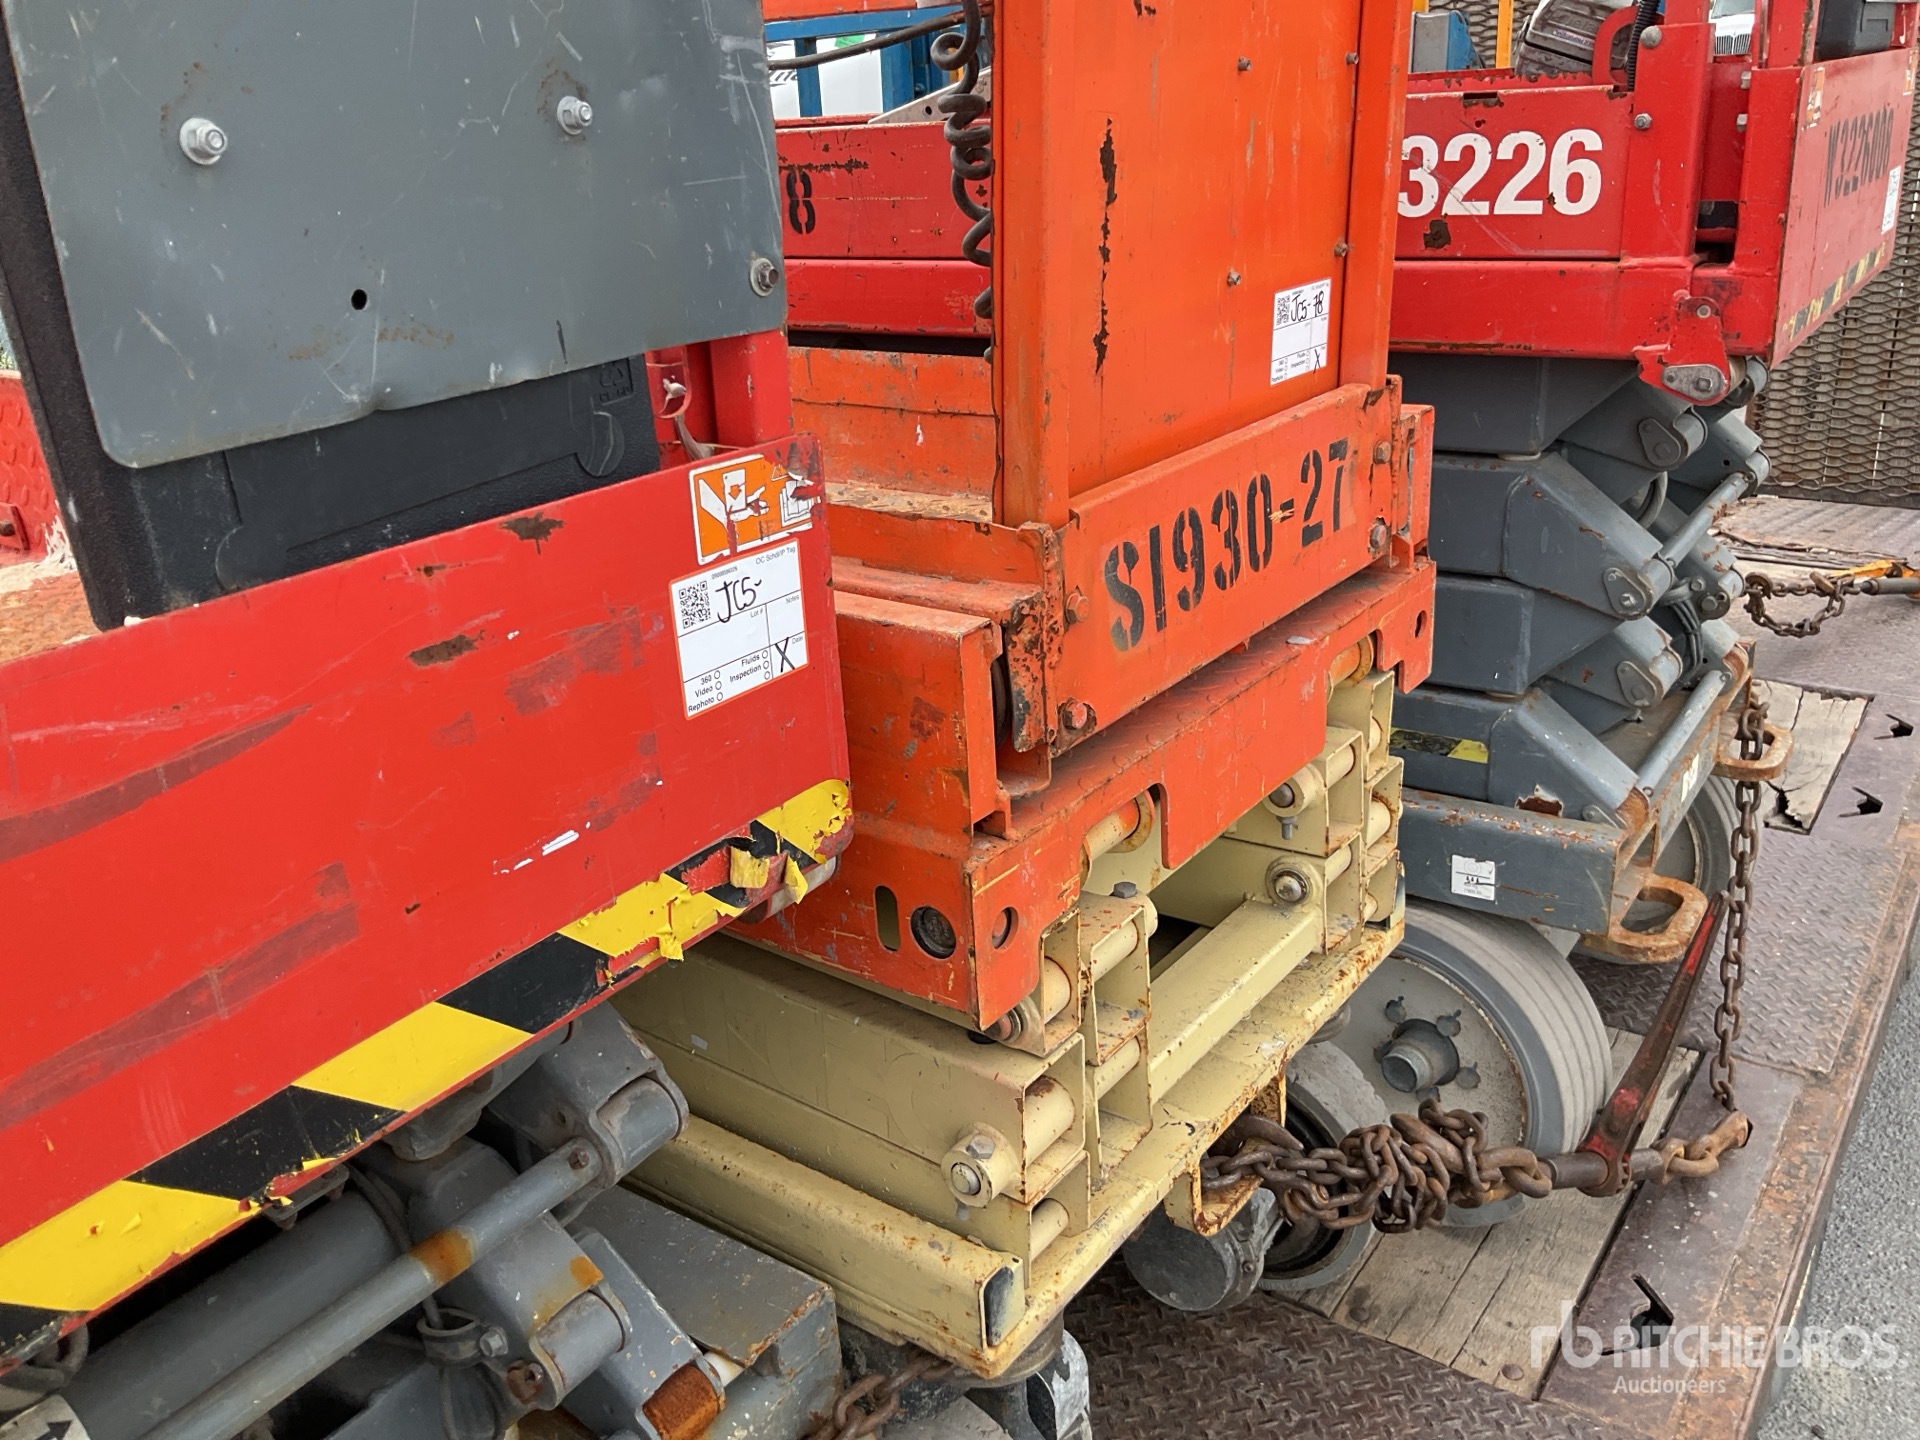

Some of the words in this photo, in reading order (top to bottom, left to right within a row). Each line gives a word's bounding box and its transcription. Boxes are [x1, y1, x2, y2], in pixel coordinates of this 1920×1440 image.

[1398, 129, 1603, 218] 3226
[786, 546, 796, 555] Tag
[741, 655, 760, 667] Fluids
[729, 665, 762, 683] Inspection
[700, 675, 713, 686] 360
[694, 686, 714, 698] Video
[688, 697, 715, 713] Rephoto
